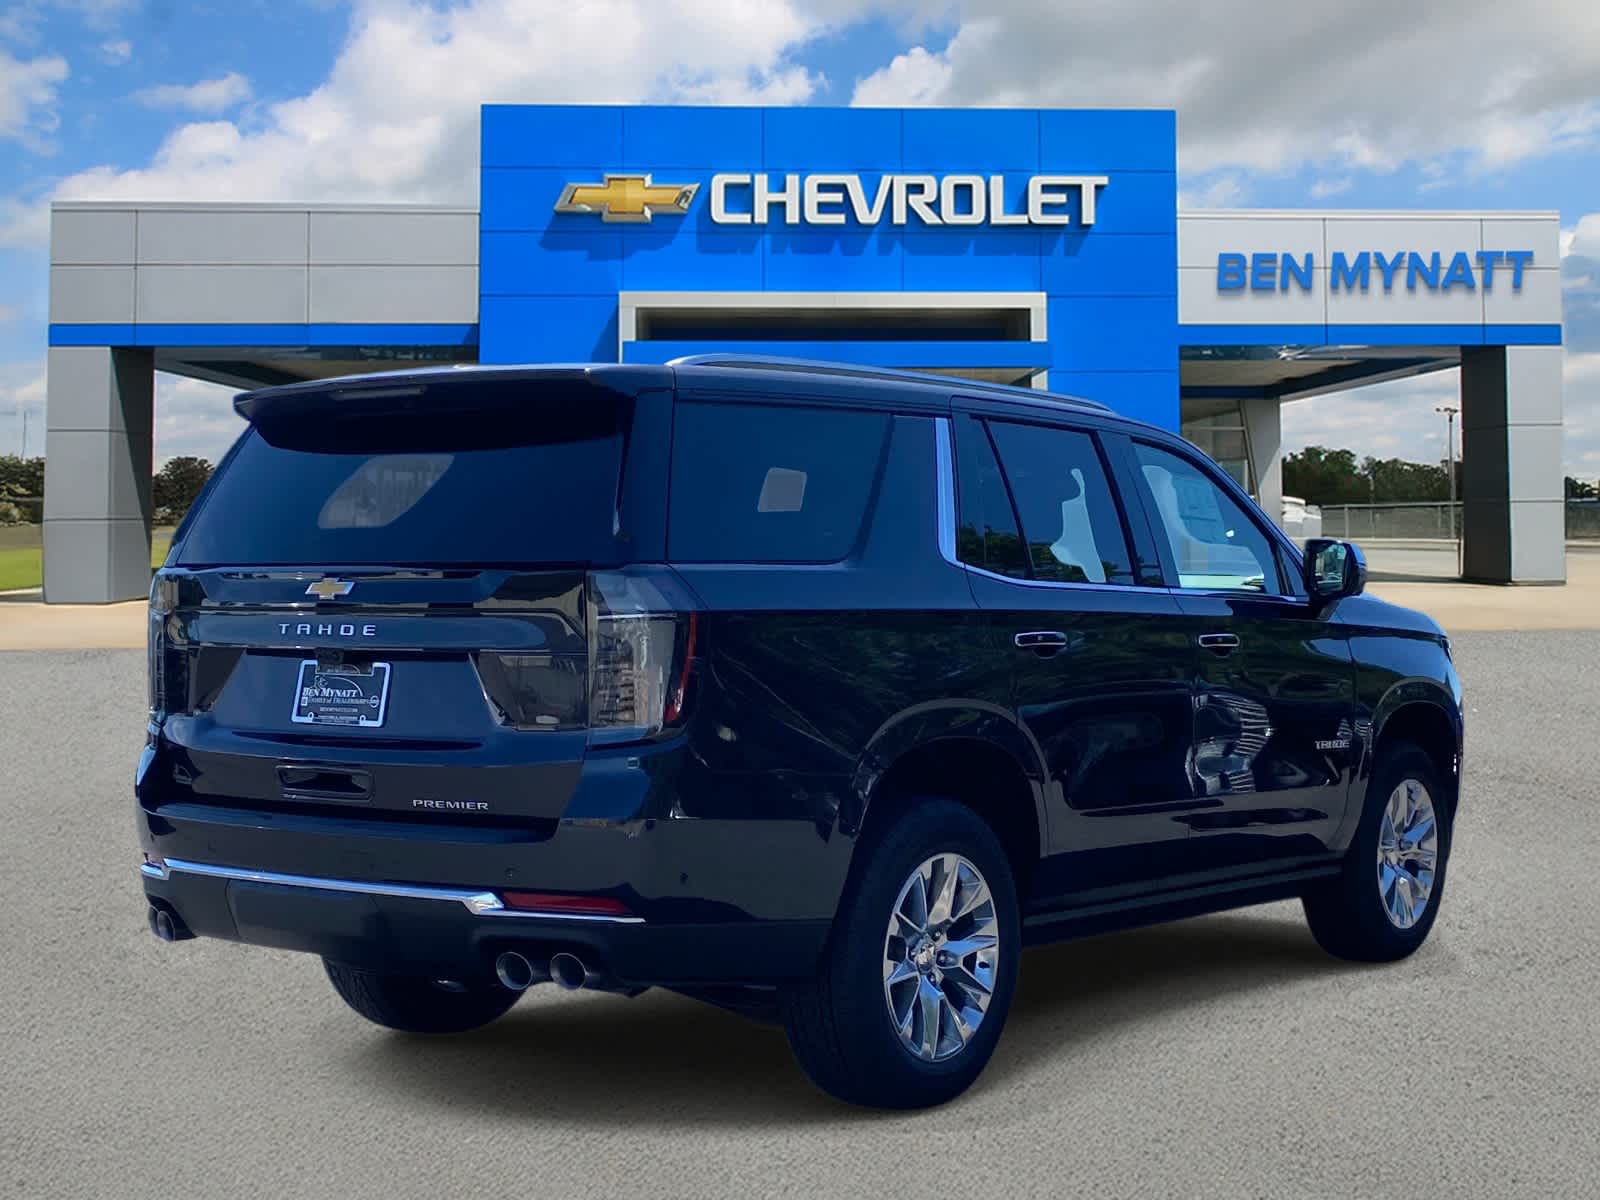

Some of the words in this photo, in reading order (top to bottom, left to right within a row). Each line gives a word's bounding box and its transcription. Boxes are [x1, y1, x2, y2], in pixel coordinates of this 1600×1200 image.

[711, 174, 1109, 225] CHEVROLET
[1217, 252, 1313, 290] BEN
[1330, 250, 1534, 290] MYNATT
[278, 623, 377, 636] TAHOE
[412, 799, 489, 810] PREMIER
